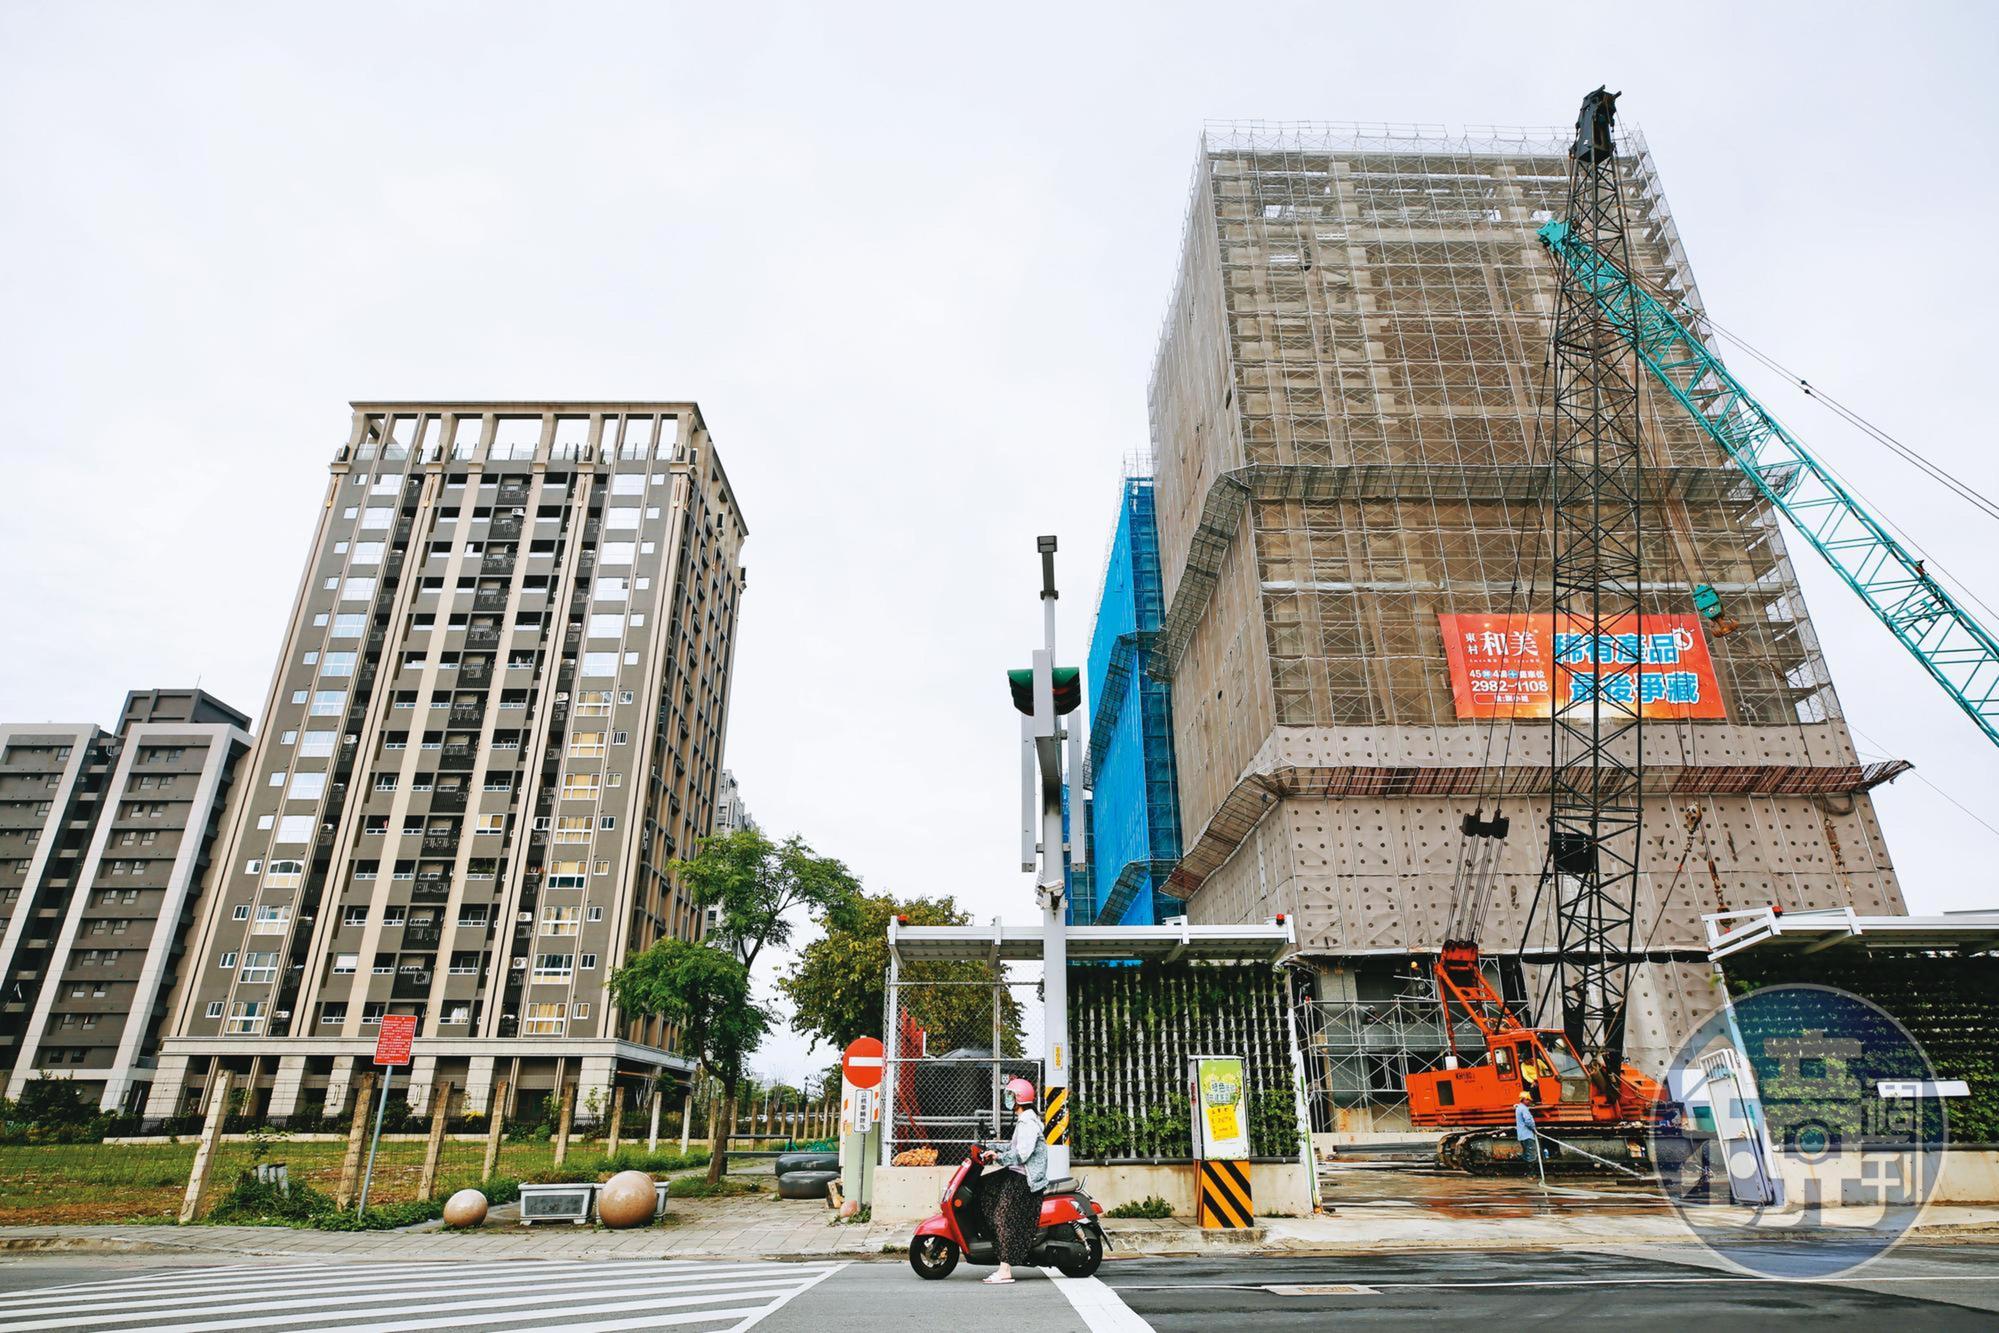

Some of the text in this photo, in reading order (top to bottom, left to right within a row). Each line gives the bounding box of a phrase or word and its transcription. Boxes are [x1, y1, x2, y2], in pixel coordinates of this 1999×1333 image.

[1465, 632, 1478, 655] 東村
[1480, 630, 1539, 656] 和美
[1552, 633, 1679, 664] 稀有產品
[1471, 680, 1548, 692] 2982-1108
[1570, 671, 1700, 704] 最後爭藏
